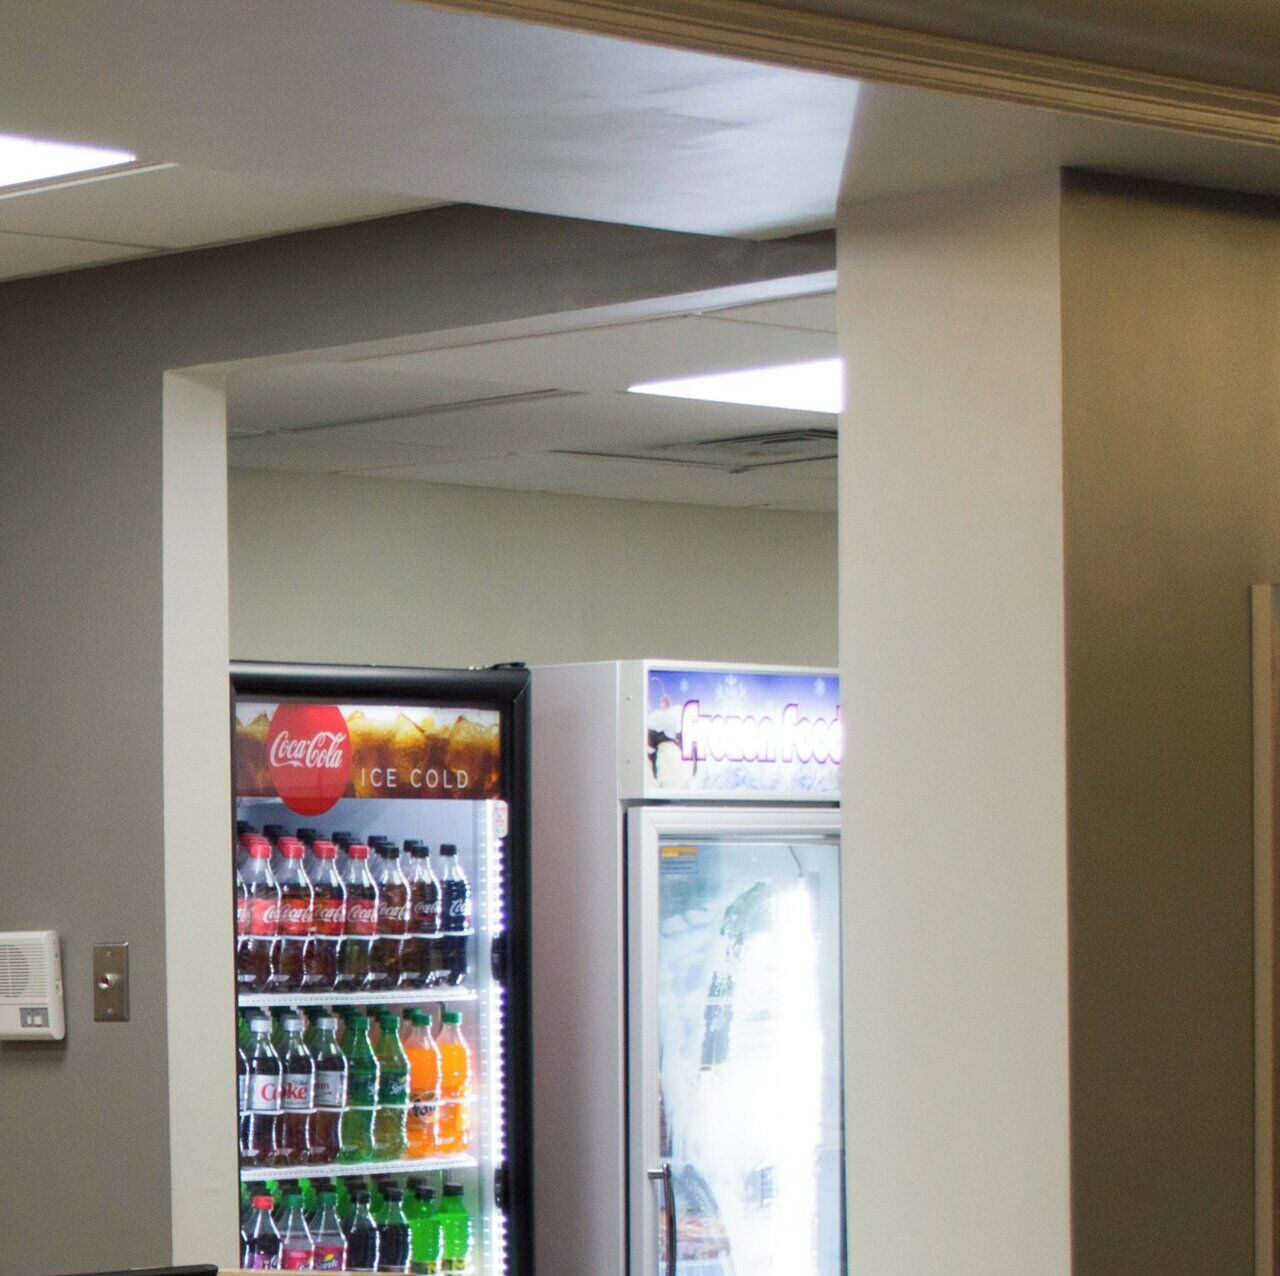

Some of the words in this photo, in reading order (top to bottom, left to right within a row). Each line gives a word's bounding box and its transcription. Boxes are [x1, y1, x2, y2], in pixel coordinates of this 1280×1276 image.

[269, 730, 347, 769] Coca-Cola
[360, 768, 397, 788] ICE
[410, 768, 469, 789] COLD
